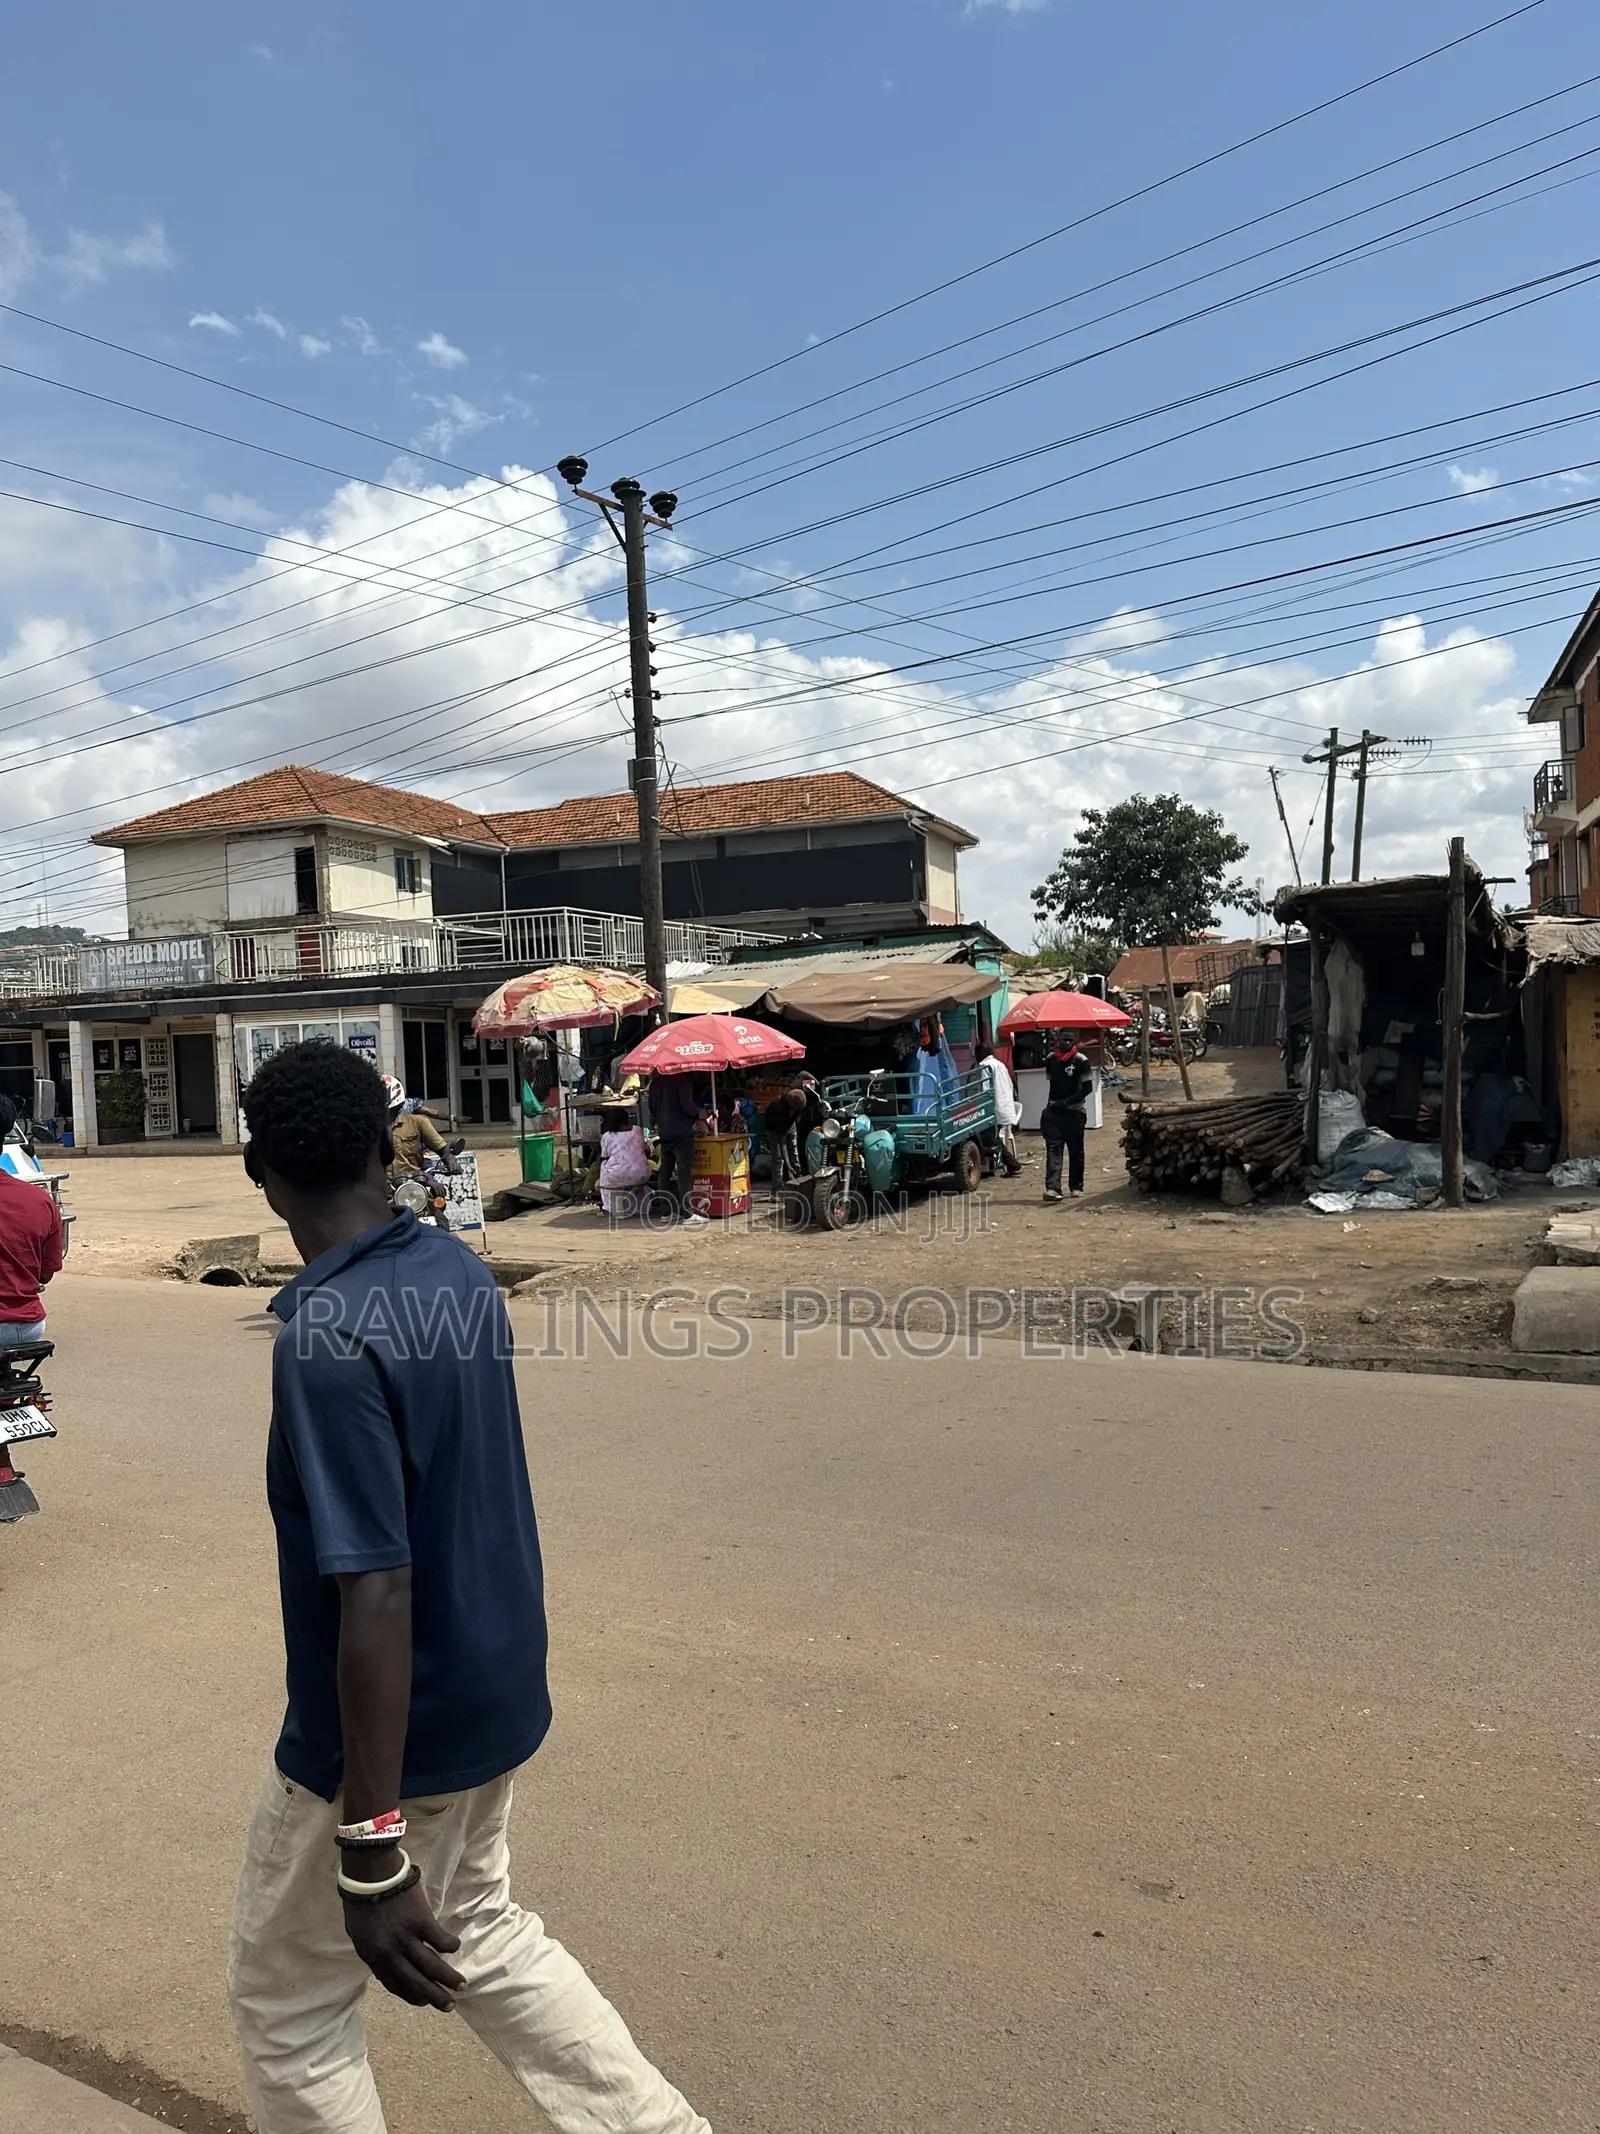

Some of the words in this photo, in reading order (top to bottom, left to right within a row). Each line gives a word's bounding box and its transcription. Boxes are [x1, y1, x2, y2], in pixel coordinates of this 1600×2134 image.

[106, 944, 153, 966] SPEDO
[156, 939, 205, 962] MOTEL
[110, 968, 137, 977] MASTERS
[146, 965, 184, 975] HOSPITALITY
[737, 1034, 764, 1045] airtel
[1, 1409, 33, 1423] UMA
[4, 1420, 52, 1438] 559CL
